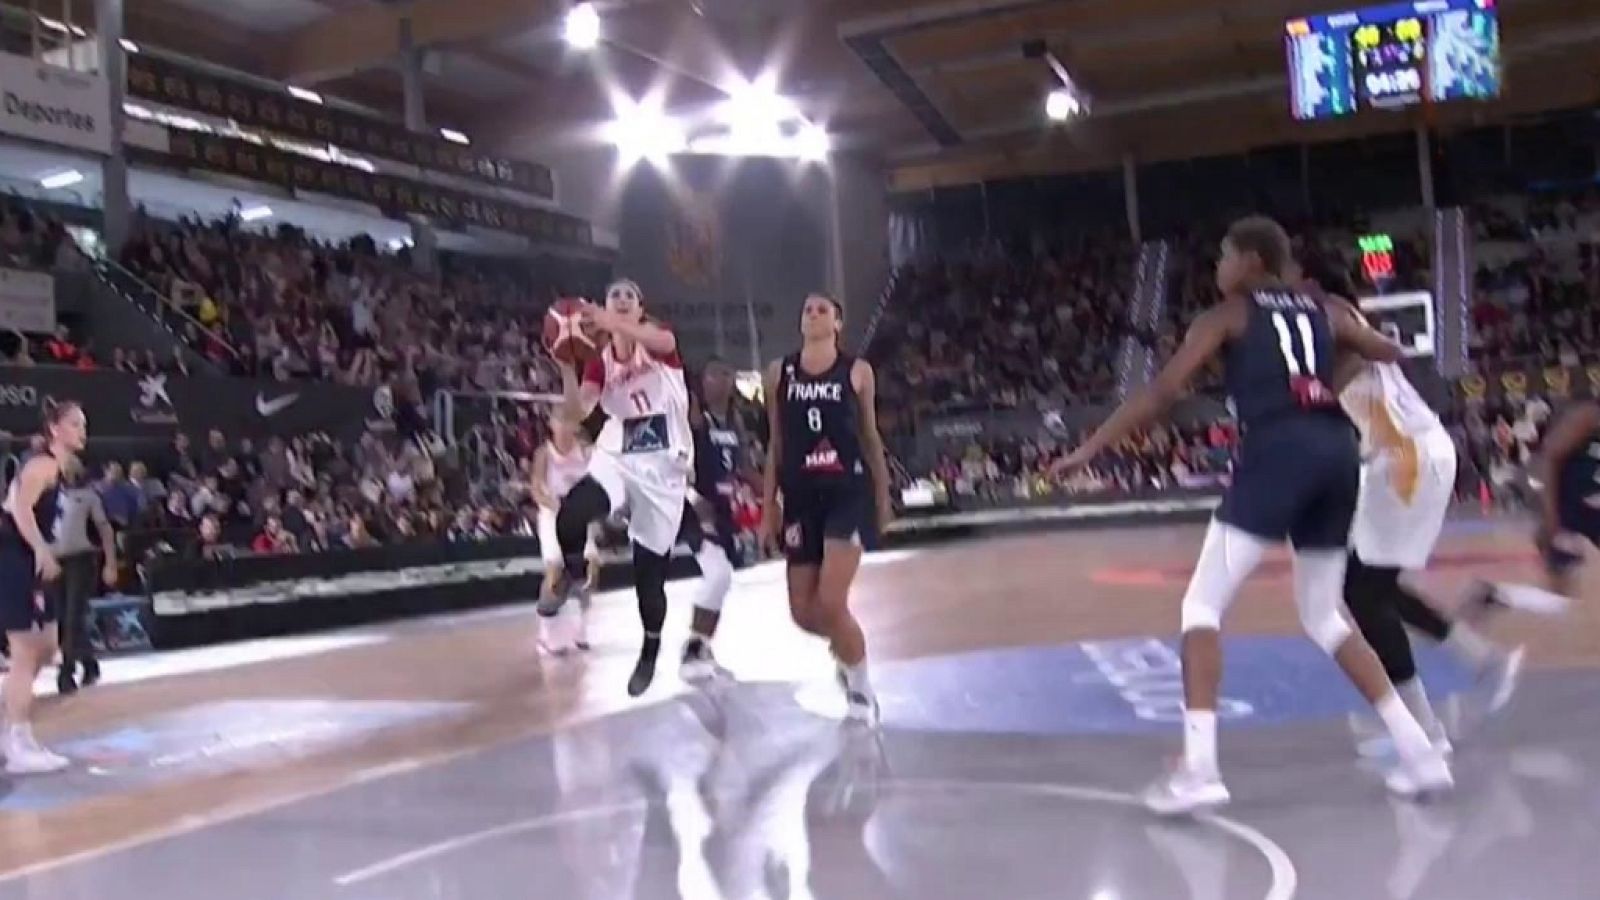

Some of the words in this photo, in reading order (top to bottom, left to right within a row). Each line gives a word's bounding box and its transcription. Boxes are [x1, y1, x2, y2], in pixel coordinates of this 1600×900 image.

[4, 91, 95, 133] Deportes
[1271, 311, 1316, 375] 11
[630, 389, 651, 415] 11
[787, 382, 842, 402] FRANCE
[807, 407, 822, 432] 8
